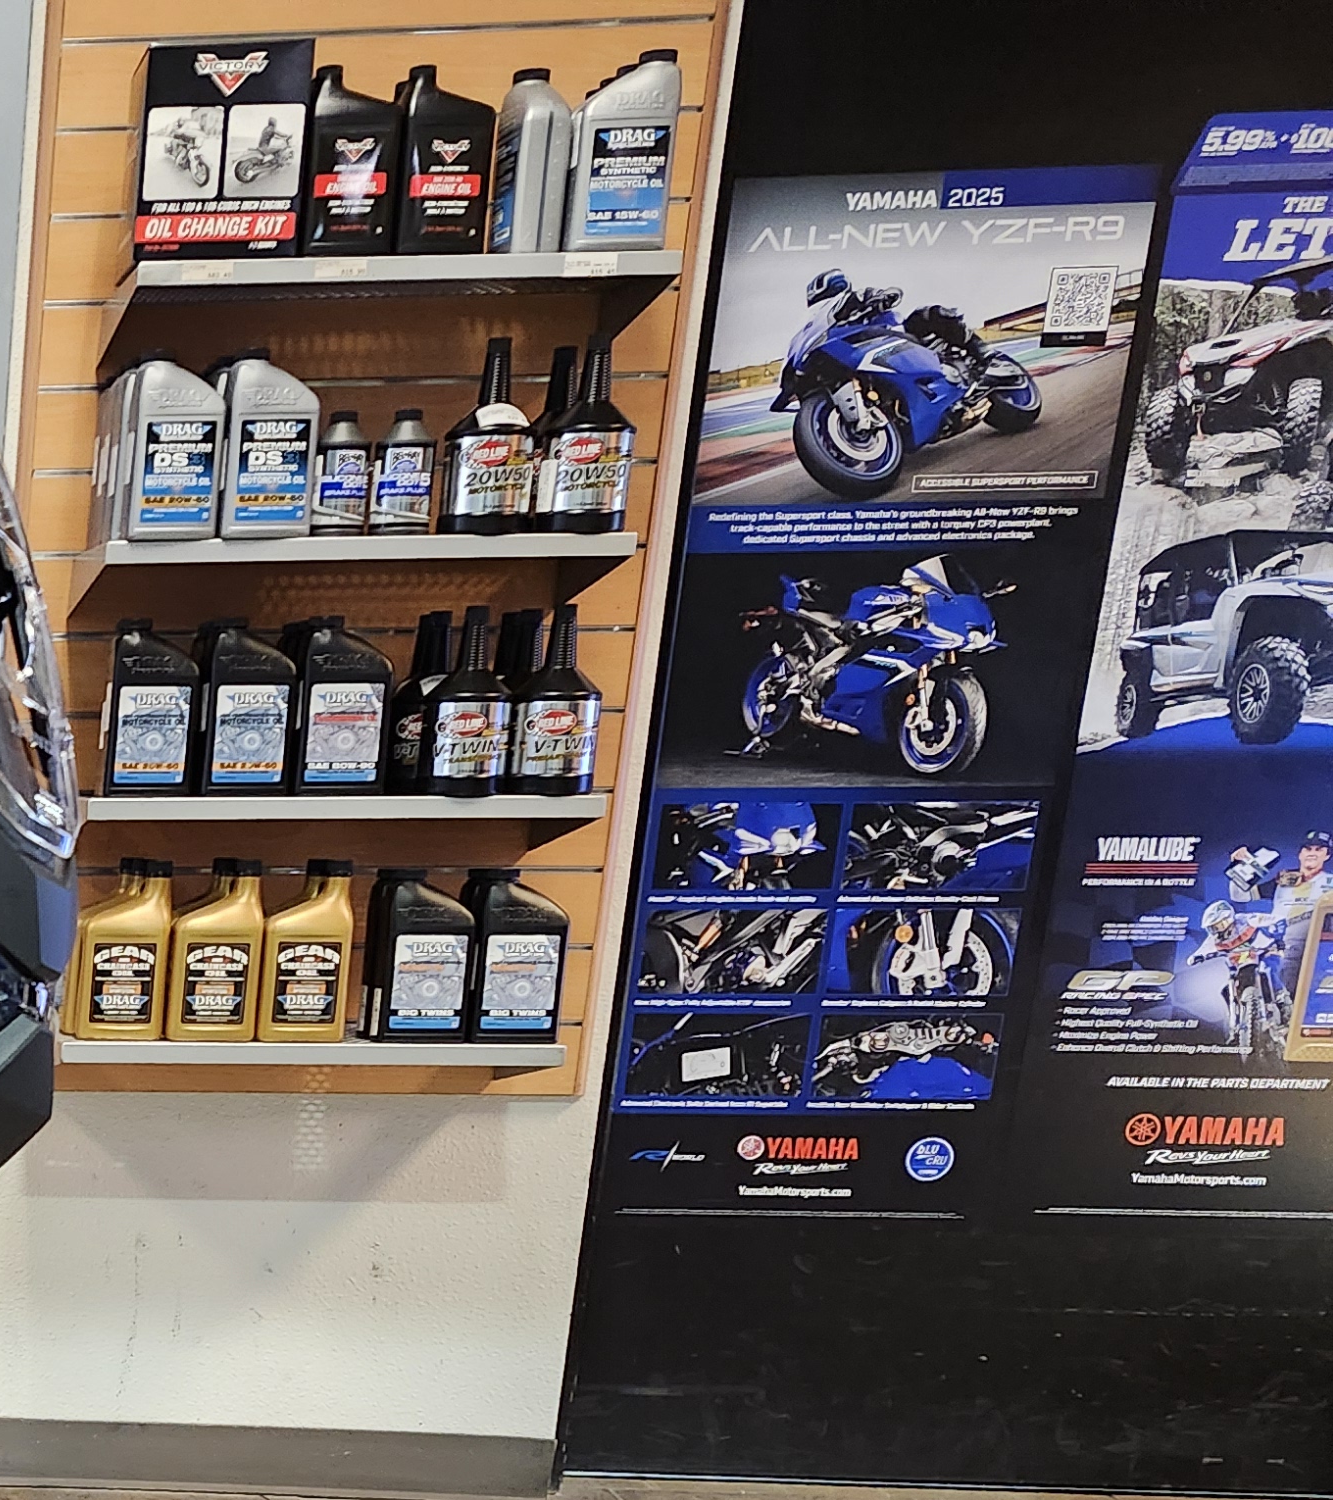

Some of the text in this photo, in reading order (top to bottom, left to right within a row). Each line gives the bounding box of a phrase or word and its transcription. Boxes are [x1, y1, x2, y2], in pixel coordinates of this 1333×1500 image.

[196, 60, 269, 72] VICTORY
[609, 129, 658, 143] DRAG
[593, 156, 666, 168] PREMIUM
[600, 167, 657, 176] SYNTHETIC
[421, 182, 456, 195] ENGINE
[589, 179, 665, 190] MOTORCYCLE OIL
[846, 186, 1005, 211] YAMAHA 2025
[1282, 195, 1329, 213] THE
[587, 211, 613, 221] SAE
[144, 214, 288, 239] OIL CHANGE KIT
[748, 215, 1126, 254] ALL-NEW YZF-R9
[161, 423, 204, 436] DRAG
[255, 422, 298, 435] DRAG
[149, 443, 213, 454] PREMIUM
[242, 441, 307, 452] PREMIUM
[154, 466, 204, 474] SYNTHETIC
[145, 475, 212, 486] MOTORCYCLE OIL
[239, 474, 306, 485] MOTORCYCLE OIL
[464, 469, 530, 487] 20W50
[920, 475, 1090, 487] ACCESSIBLE SUPERSPORT PERFORMANCE
[708, 506, 1079, 522] Redefining the Supersport groundbreaking All-New YZF-R9 brings
[730, 520, 996, 532] track-capable performance to the street with CP3
[742, 531, 993, 544] dedicated Supersport chassis and advanced electronics
[137, 692, 177, 706] DRAG
[234, 692, 275, 705] DRAG
[326, 690, 367, 704] DRAG
[121, 717, 174, 726] MOTORCYCLE
[220, 717, 270, 726] MOTORCYCLE
[1097, 836, 1199, 862] YAMALUBE
[277, 944, 340, 965] GEAR
[413, 942, 454, 955] DRAG
[504, 942, 546, 955] DRAG
[93, 946, 156, 965] GEAR
[186, 946, 249, 966] GEAR
[1067, 970, 1175, 991] GP
[102, 994, 141, 1006] DRAG
[194, 994, 233, 1006] DRAG
[285, 994, 325, 1006] DRAG
[420, 1009, 455, 1017] TWINS
[512, 1009, 547, 1017] TWINS
[1106, 1077, 1330, 1090] AVAILABLE IN THE PARTS DEPARTMENT
[1164, 1116, 1285, 1146] YAMAHA
[766, 1137, 860, 1160] YAMAHA
[1144, 1149, 1270, 1166] Revs Your Heart
[1131, 1172, 1267, 1187] YamahaMotorsports.com
[737, 1185, 852, 1199] YamahaMotorsports.com
